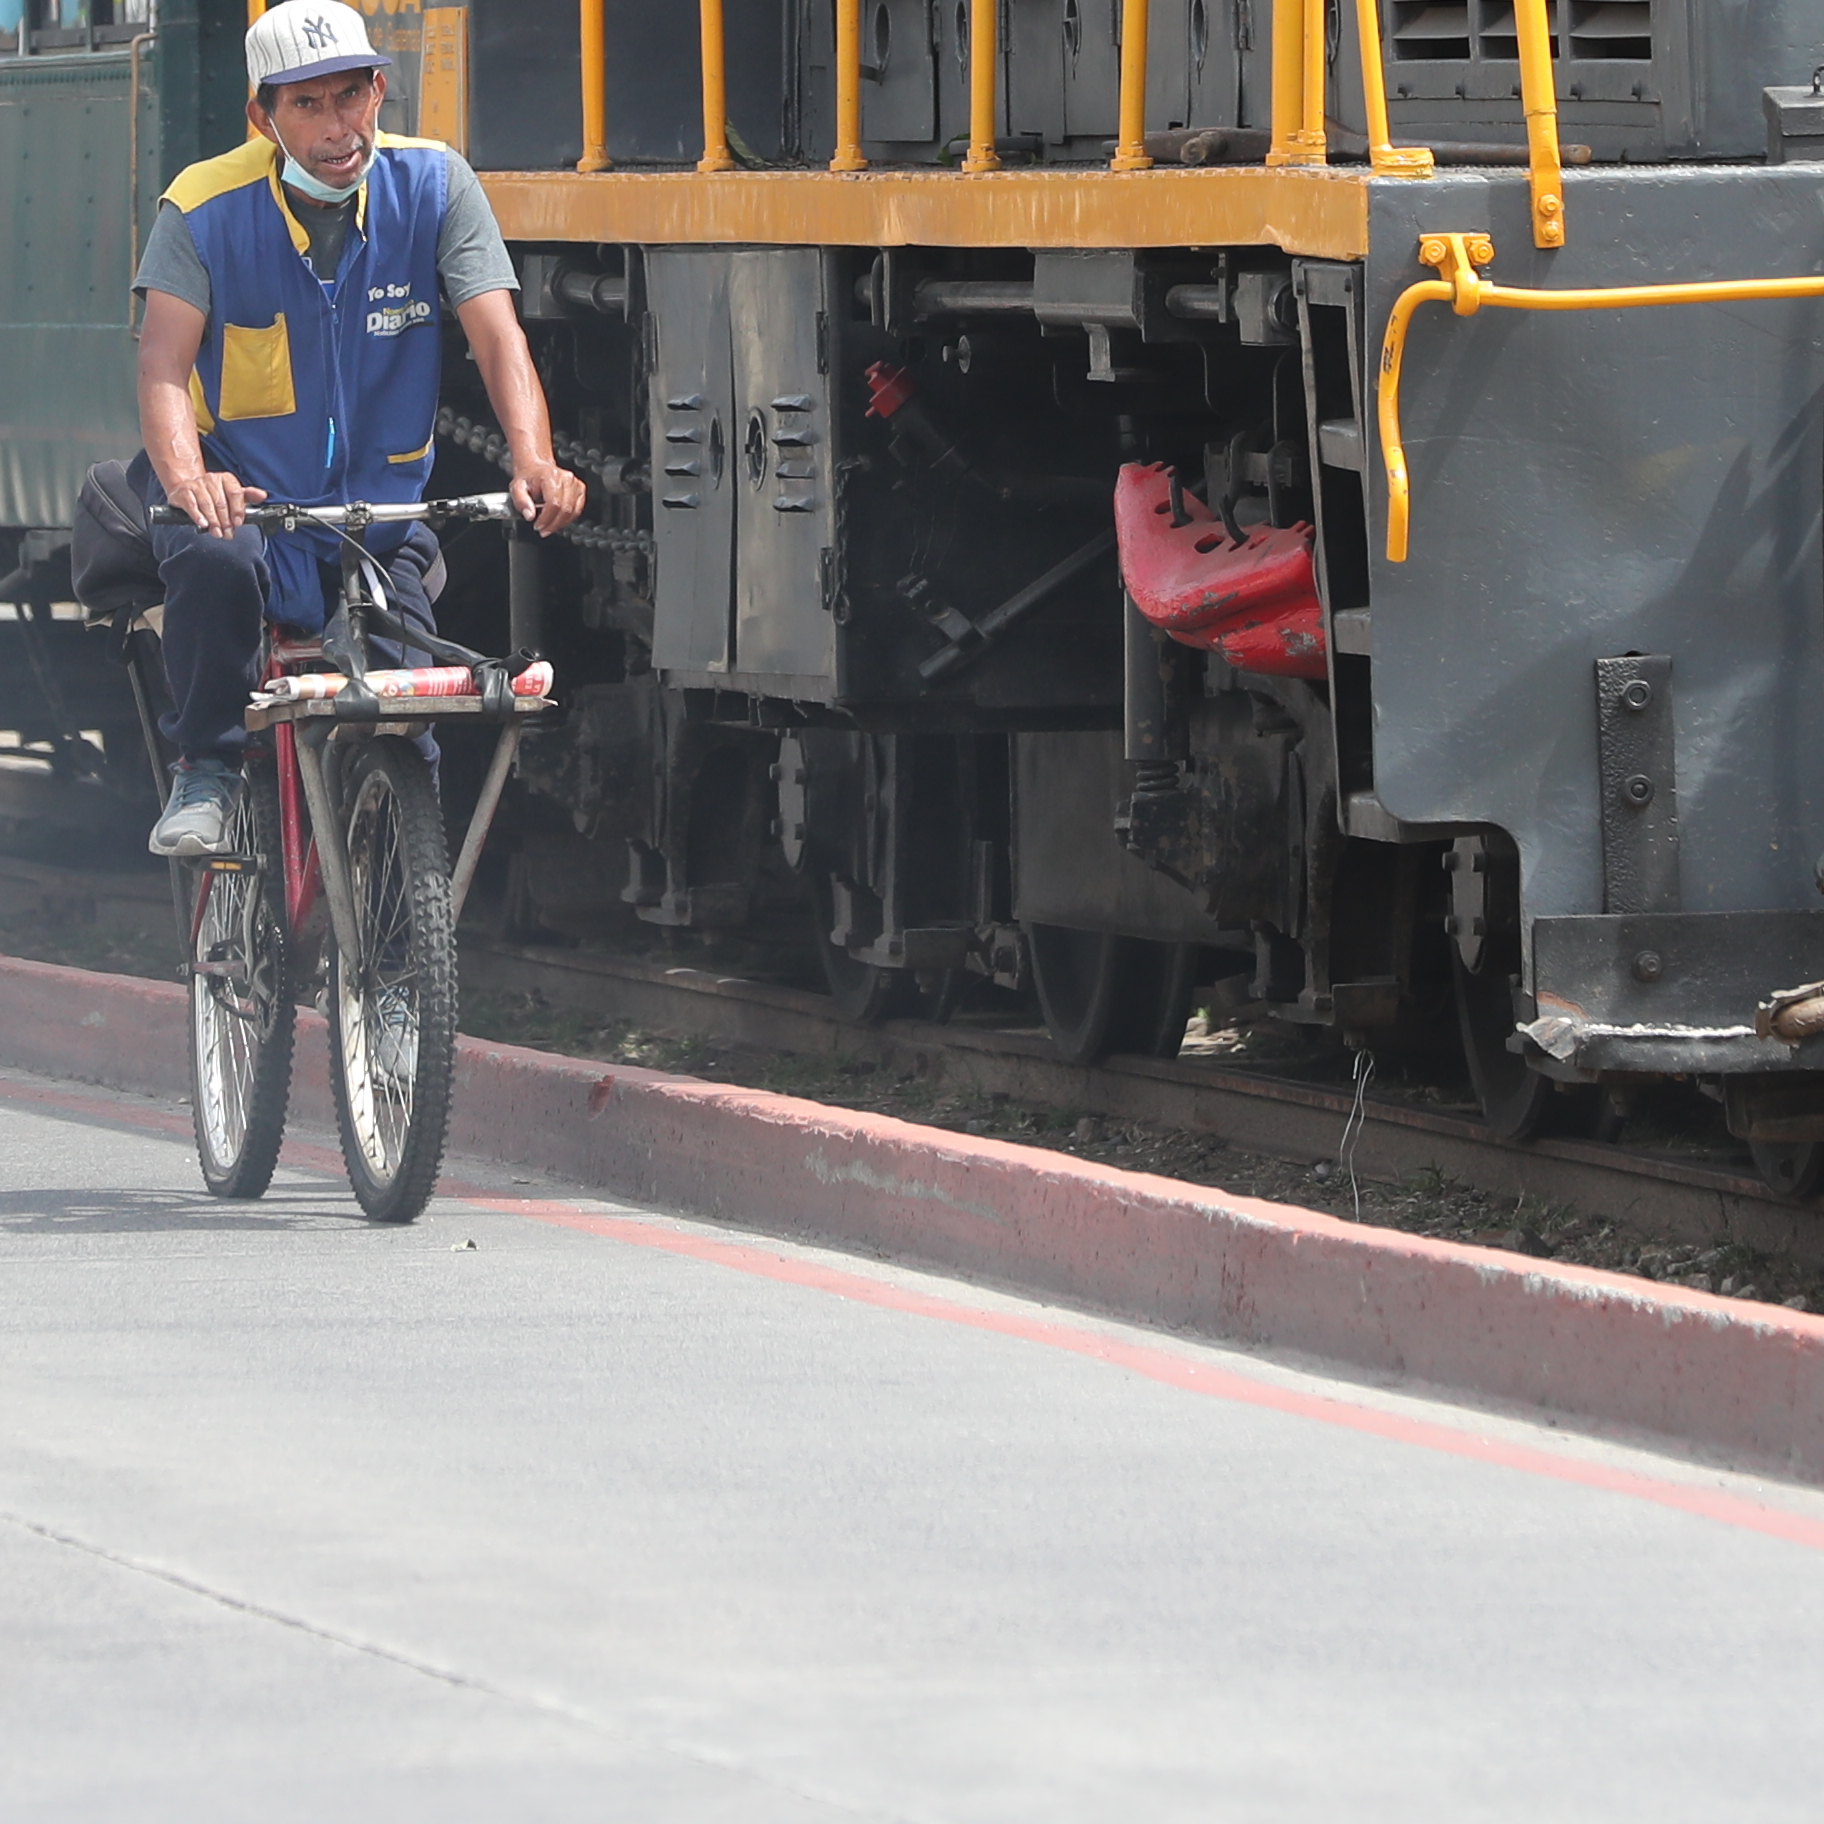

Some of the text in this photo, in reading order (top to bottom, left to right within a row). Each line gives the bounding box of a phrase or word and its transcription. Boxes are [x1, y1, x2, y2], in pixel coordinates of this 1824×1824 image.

[301, 15, 339, 49] NY
[367, 286, 384, 302] Yo
[366, 301, 430, 333] Diario
